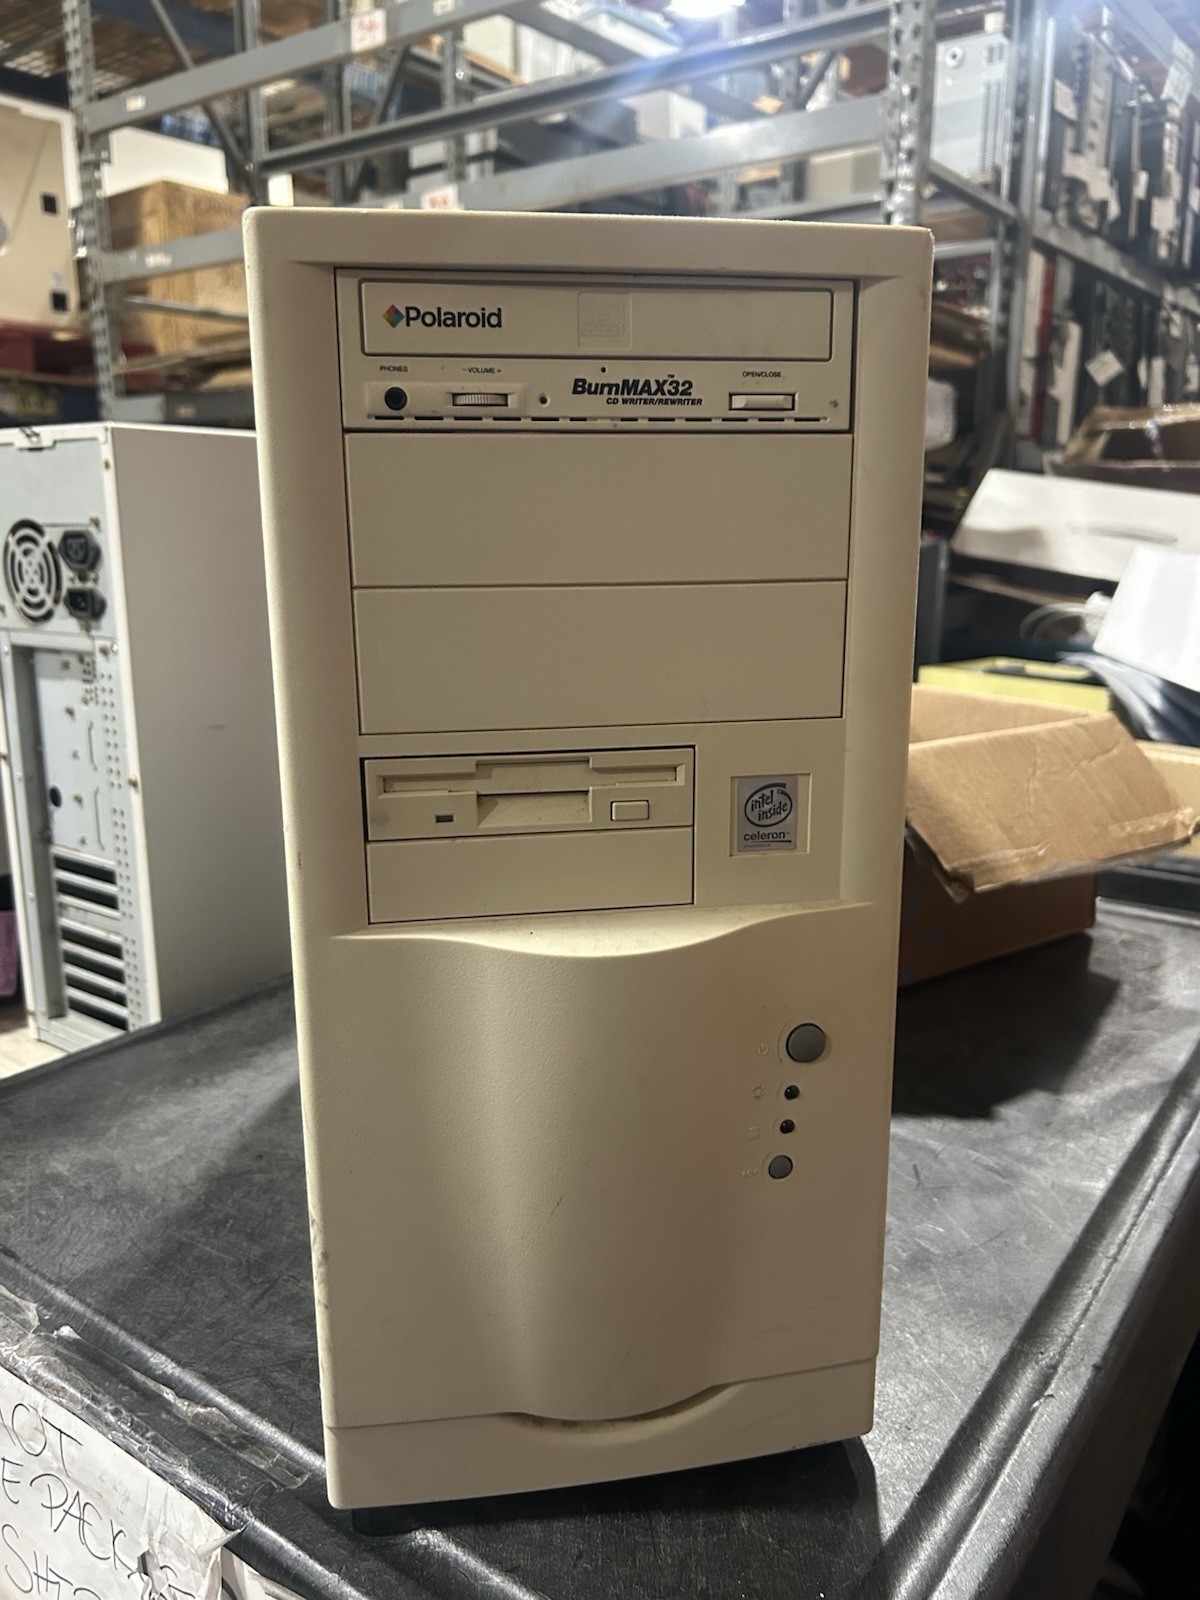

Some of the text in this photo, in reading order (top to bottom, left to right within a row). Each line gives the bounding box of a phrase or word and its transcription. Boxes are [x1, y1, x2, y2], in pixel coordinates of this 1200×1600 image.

[405, 306, 502, 328] Polaroid
[606, 397, 703, 406] CD WRITER/REWRITER
[751, 789, 774, 812] intel
[758, 801, 788, 821] inside
